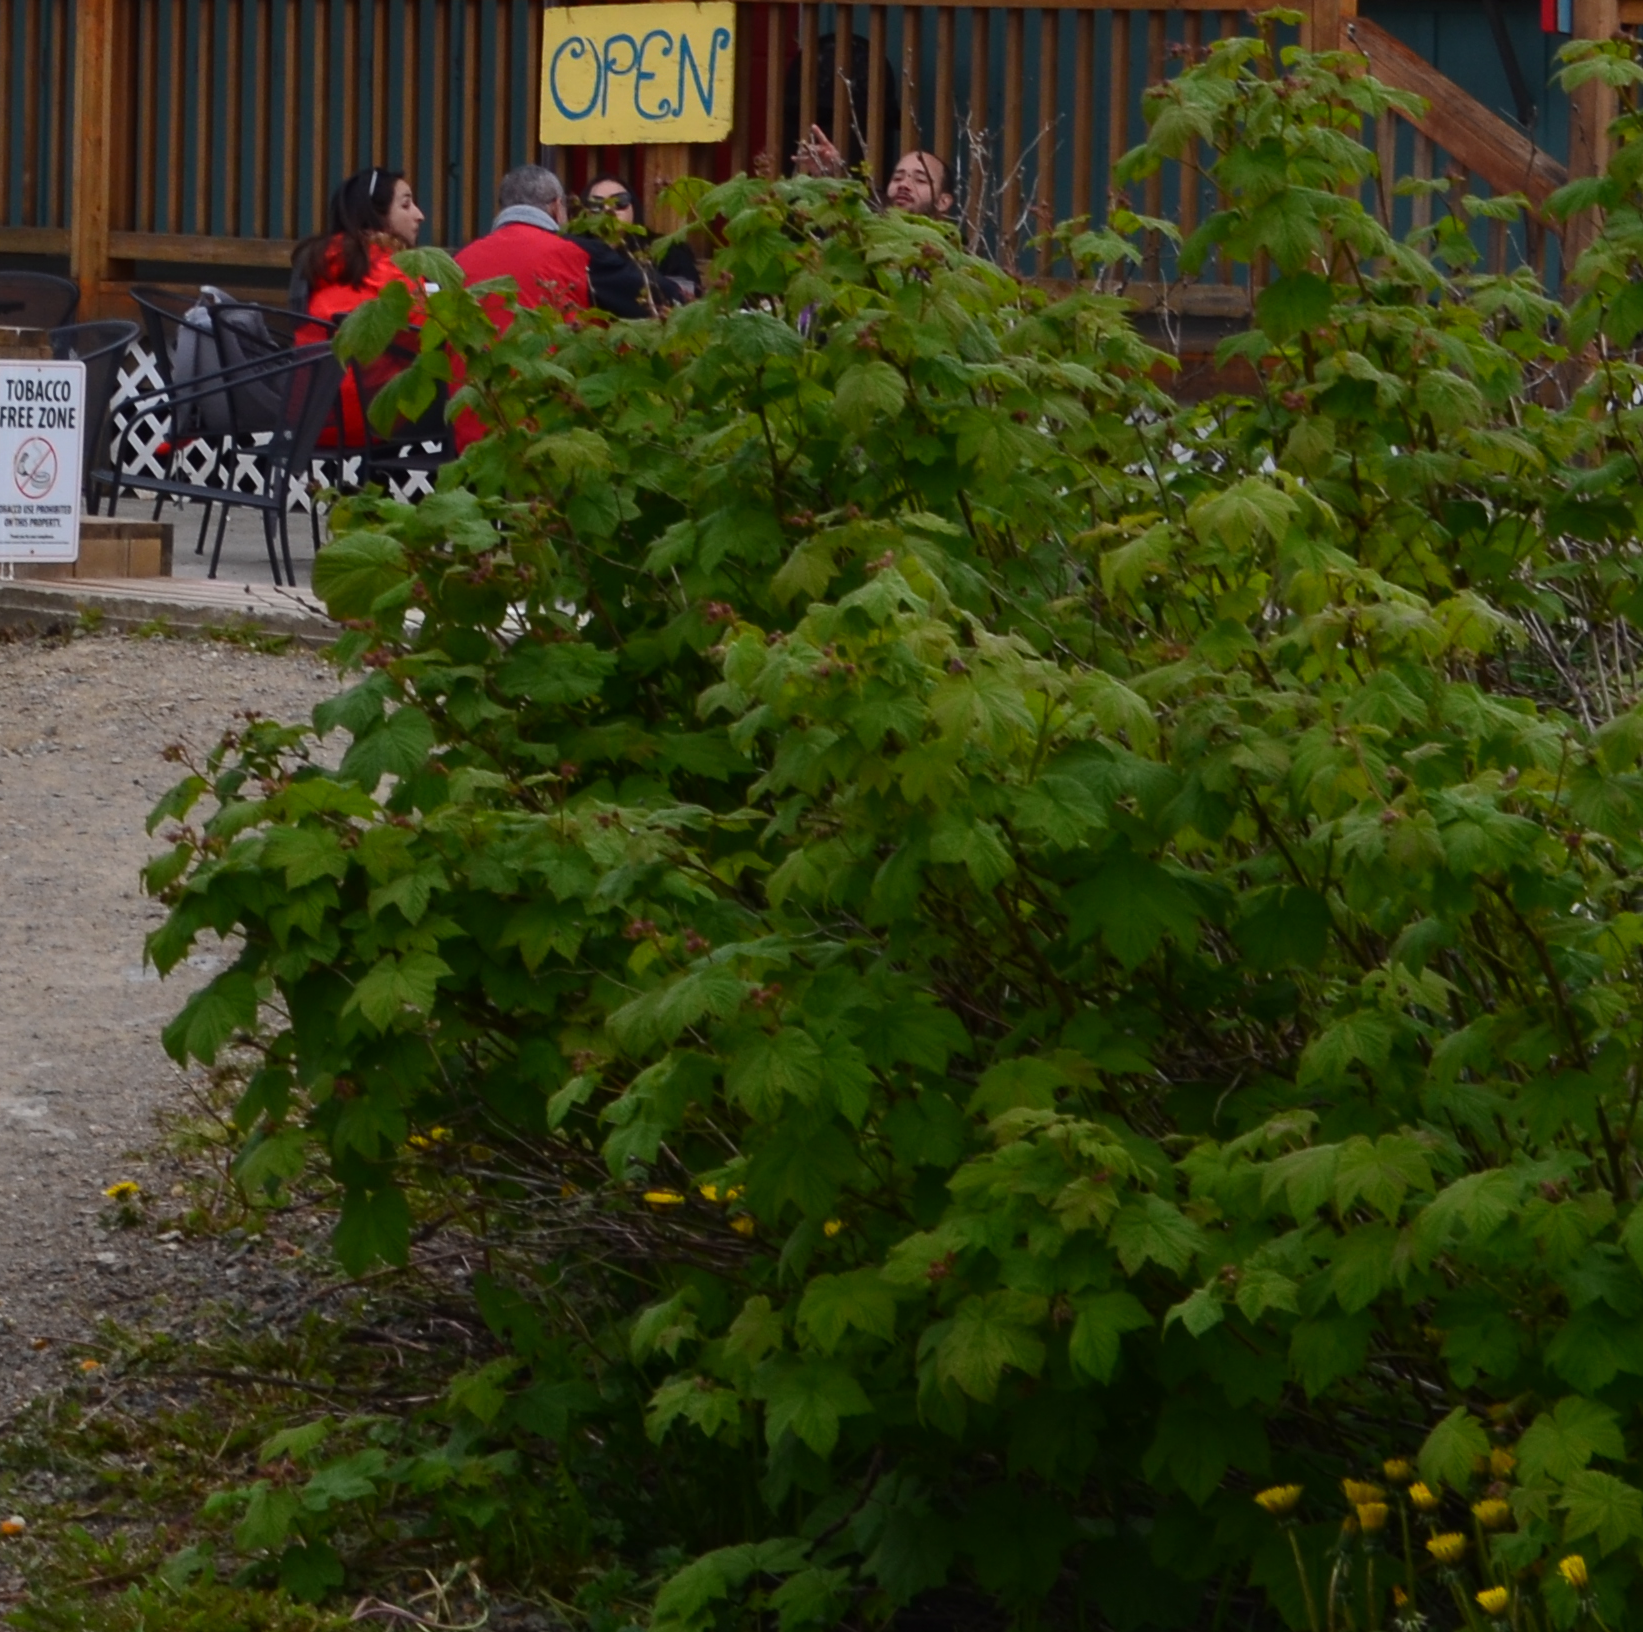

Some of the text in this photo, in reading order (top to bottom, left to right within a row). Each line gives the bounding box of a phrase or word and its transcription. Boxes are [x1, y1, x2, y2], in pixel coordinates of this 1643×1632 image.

[549, 26, 732, 121] OPEN
[6, 379, 71, 402] TOBACCO
[0, 406, 76, 429] FREE ZONE
